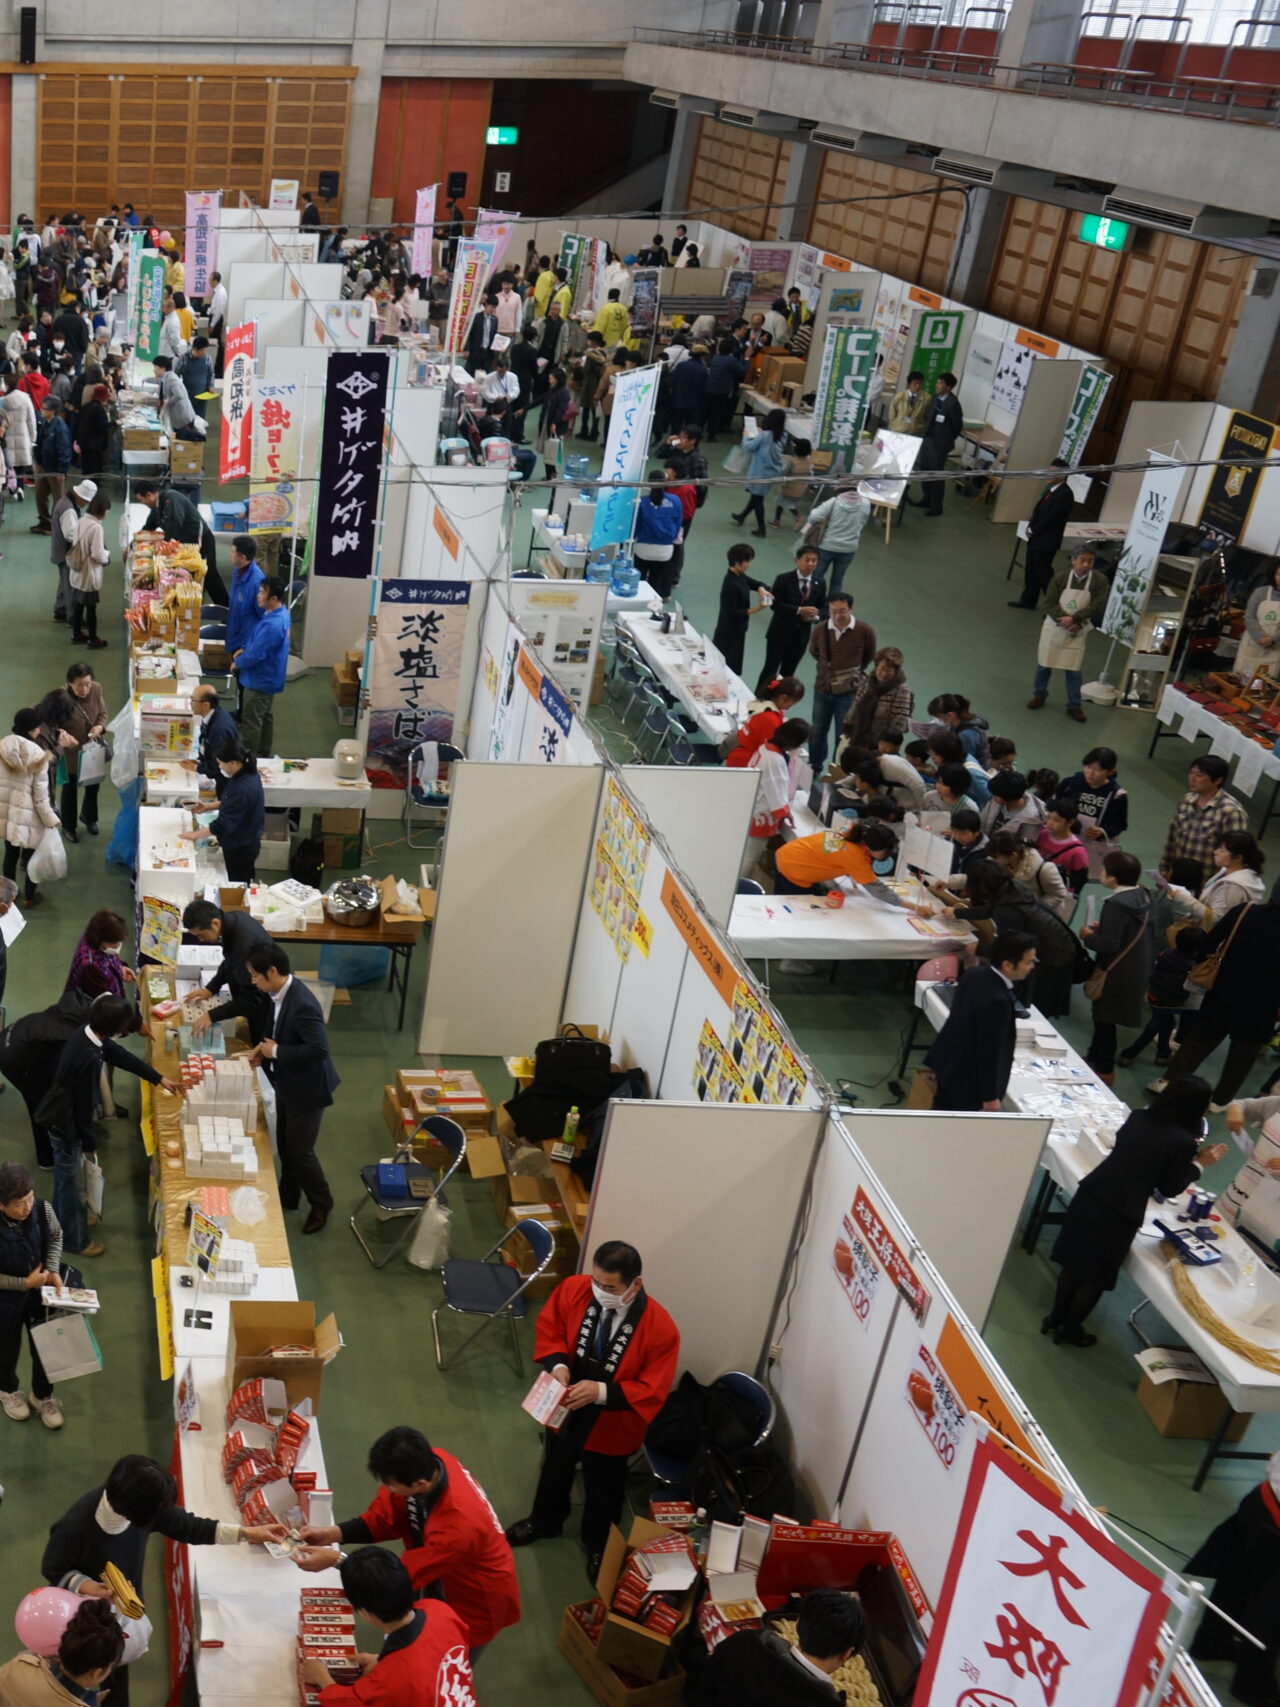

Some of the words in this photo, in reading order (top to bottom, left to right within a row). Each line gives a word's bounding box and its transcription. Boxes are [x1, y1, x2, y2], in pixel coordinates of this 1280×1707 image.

[312, 406, 377, 557] 井ゲタ竹内
[393, 609, 445, 740] 淡塩さば
